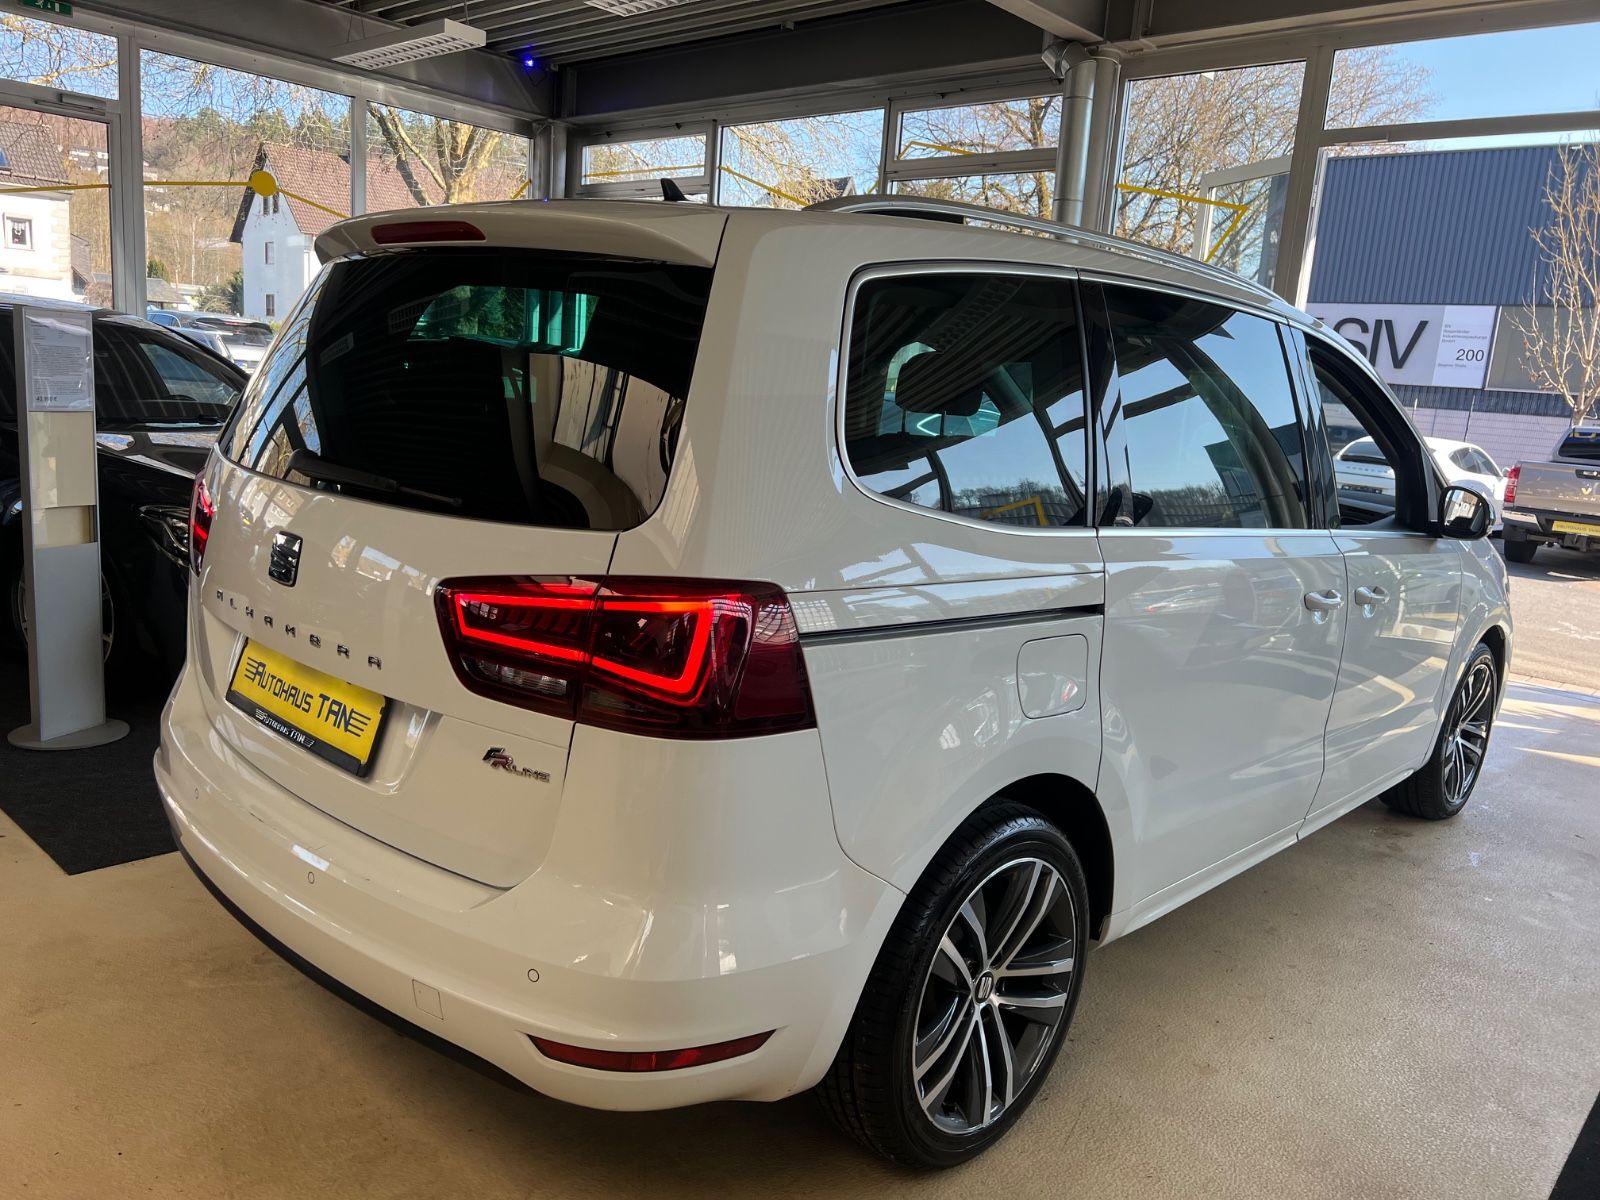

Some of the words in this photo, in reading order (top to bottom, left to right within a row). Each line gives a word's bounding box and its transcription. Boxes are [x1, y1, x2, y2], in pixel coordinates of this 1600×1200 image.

[1333, 317, 1429, 369] SIV
[1455, 348, 1485, 362] 200
[216, 589, 383, 671] ALHAMBRA
[252, 661, 314, 714] AUTOHAUS
[316, 692, 355, 733] TAN
[290, 728, 306, 744] TAN
